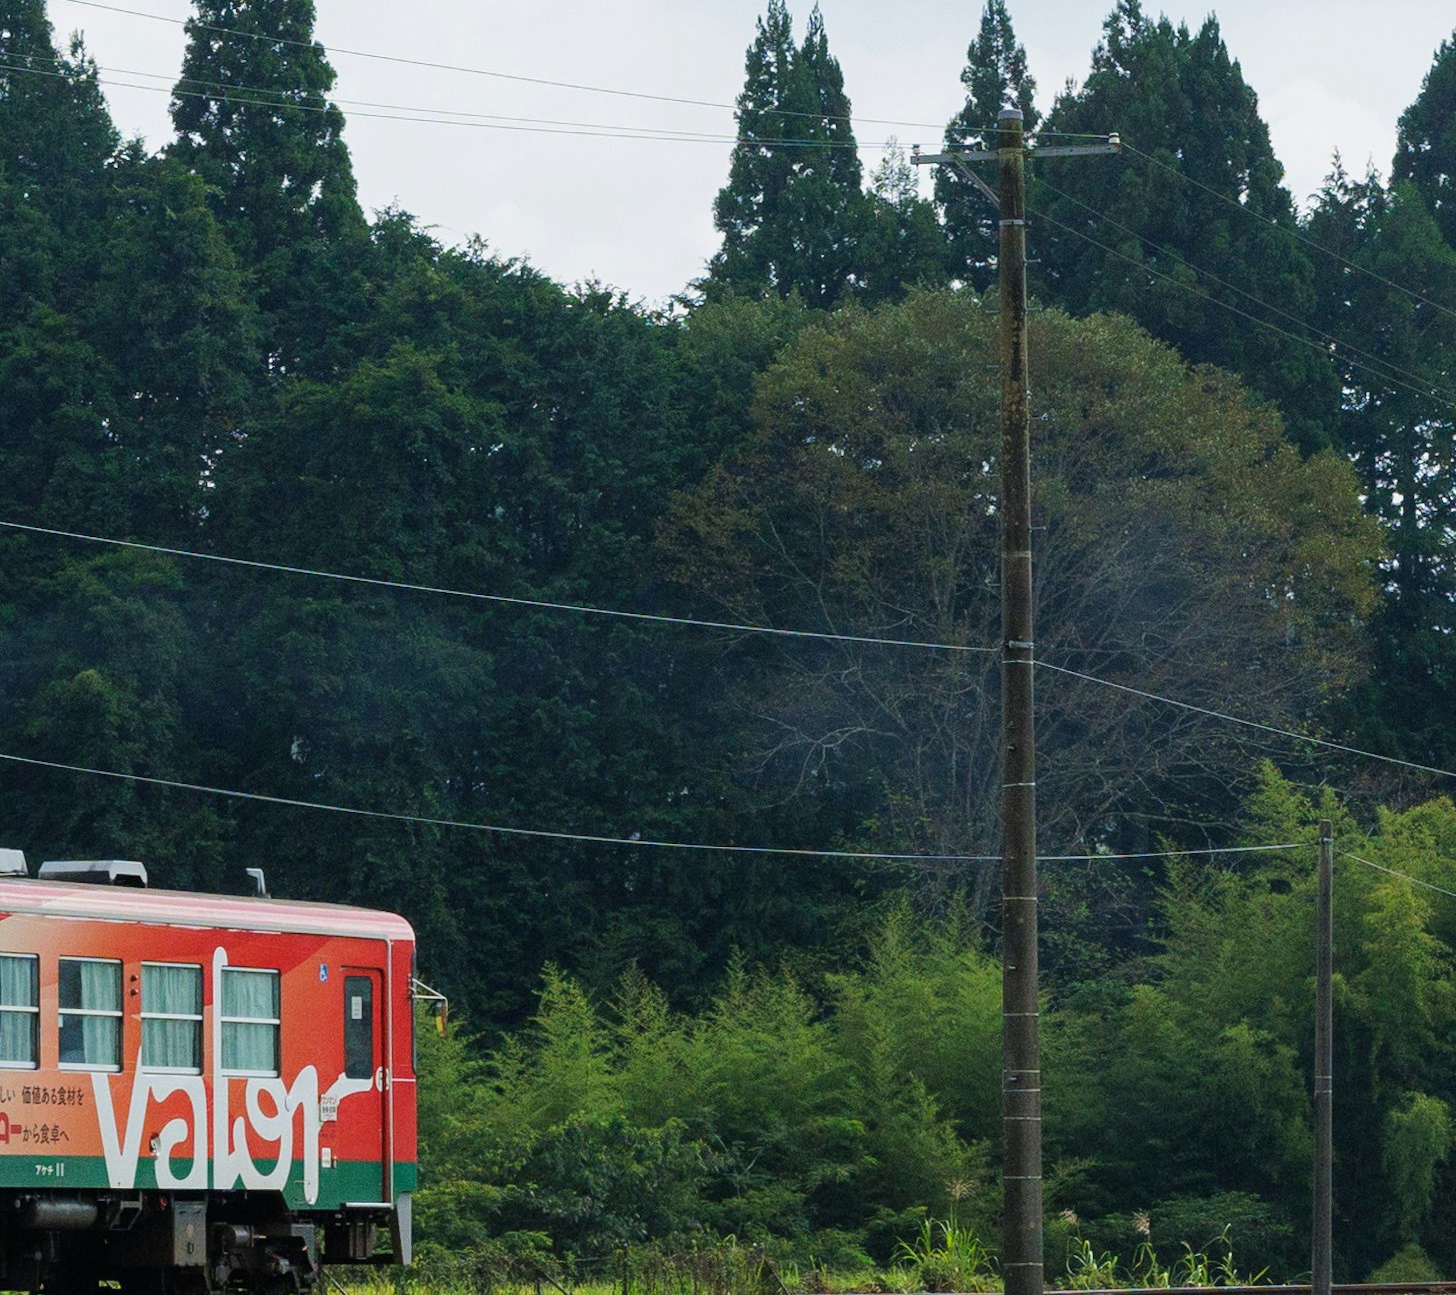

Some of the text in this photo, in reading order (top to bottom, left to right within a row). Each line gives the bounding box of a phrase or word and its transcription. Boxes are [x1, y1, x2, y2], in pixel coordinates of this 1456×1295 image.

[22, 1086, 85, 1106] 価値ある食材を
[35, 1165, 54, 1176] アケチ
